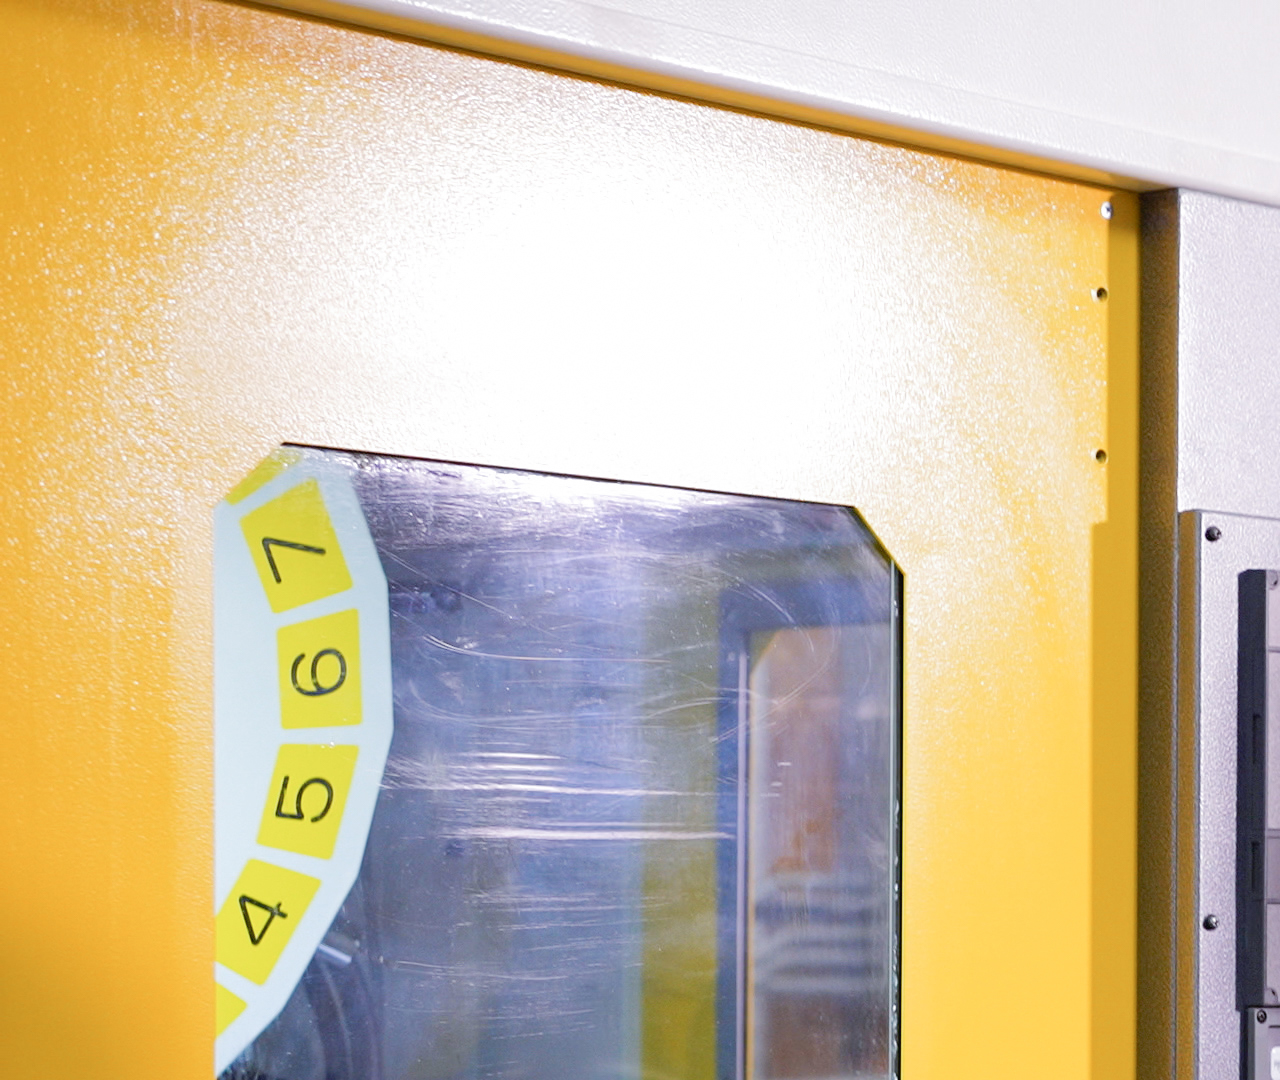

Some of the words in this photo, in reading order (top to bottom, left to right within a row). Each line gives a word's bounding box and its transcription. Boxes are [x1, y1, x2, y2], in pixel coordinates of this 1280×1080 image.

[261, 535, 326, 584] 7
[291, 647, 348, 697] 6
[275, 775, 334, 823] 5
[238, 895, 288, 946] 4
